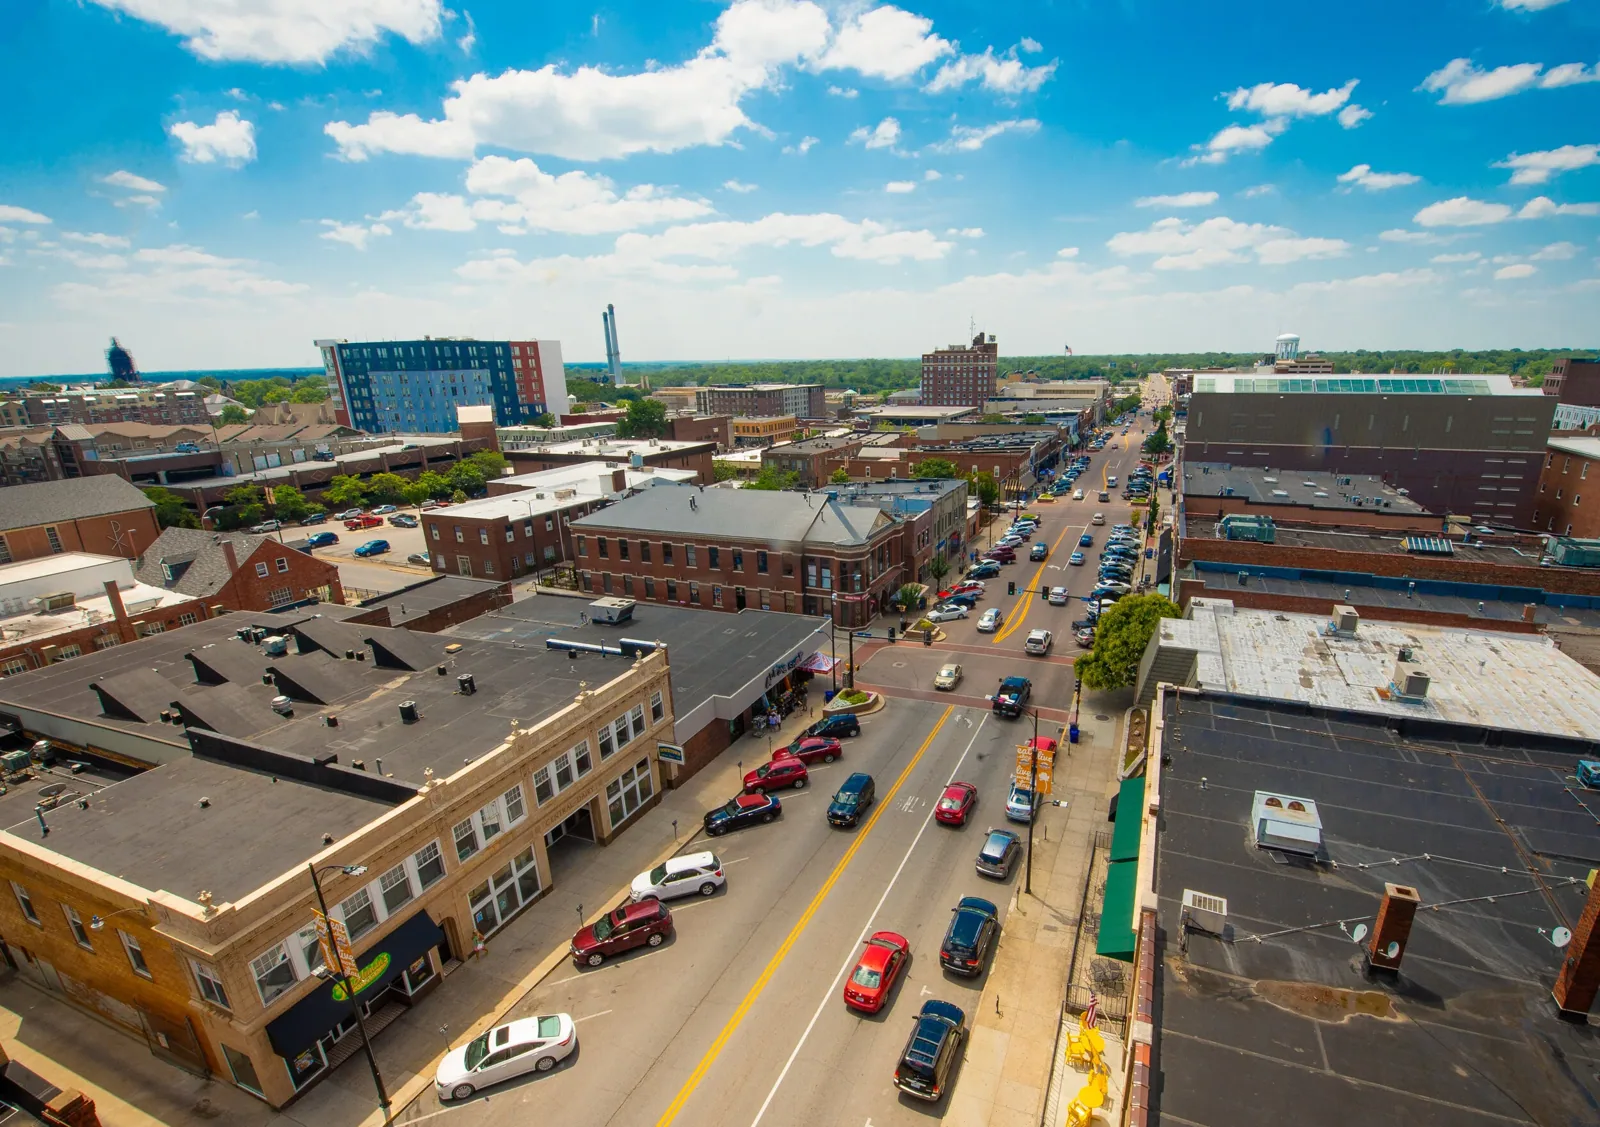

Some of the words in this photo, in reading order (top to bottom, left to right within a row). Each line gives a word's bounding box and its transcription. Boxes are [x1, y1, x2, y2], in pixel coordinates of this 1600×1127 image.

[1038, 751, 1053, 762] live
[1016, 765, 1031, 776] live
[545, 803, 574, 826] CENTRAL
